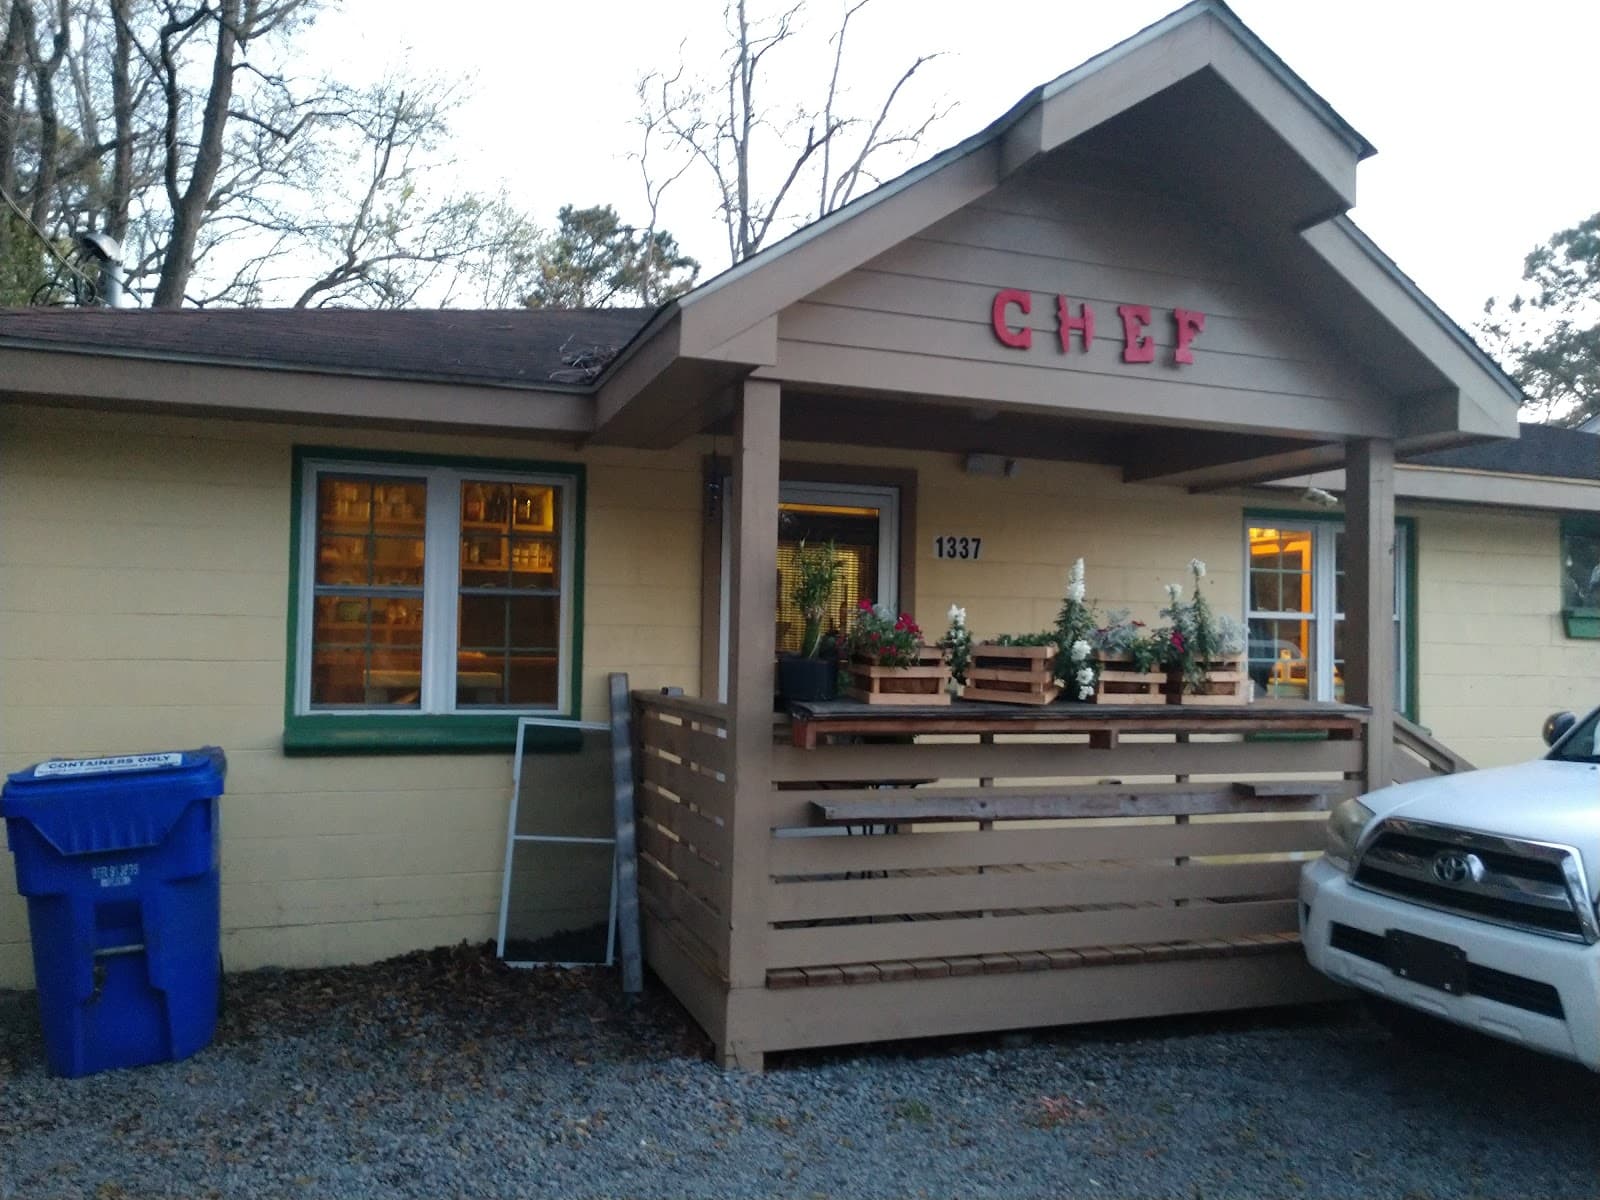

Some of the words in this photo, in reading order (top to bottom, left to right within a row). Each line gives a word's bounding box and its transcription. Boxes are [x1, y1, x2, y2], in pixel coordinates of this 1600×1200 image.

[992, 287, 1206, 364] CHEF
[935, 536, 981, 559] 1337
[48, 758, 134, 769] CONTAINERS
[138, 754, 170, 763] ONLY
